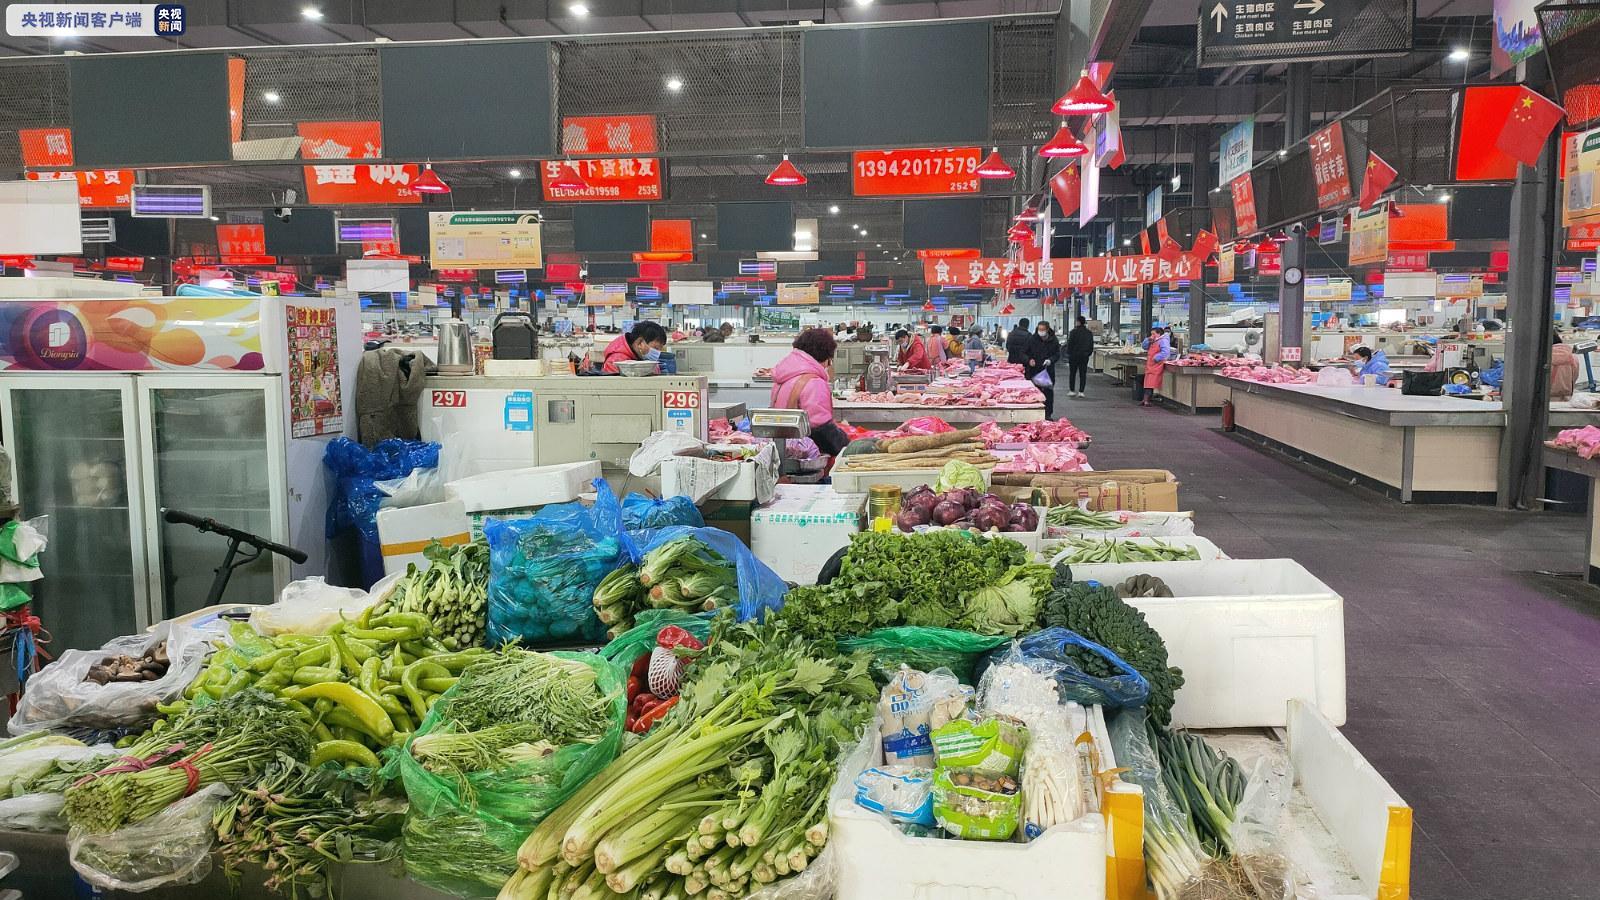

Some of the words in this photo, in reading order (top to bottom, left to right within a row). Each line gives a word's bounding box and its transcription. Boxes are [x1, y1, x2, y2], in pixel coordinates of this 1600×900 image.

[858, 157, 976, 177] 13942017579
[433, 391, 465, 406] 297
[665, 392, 699, 408] 296
